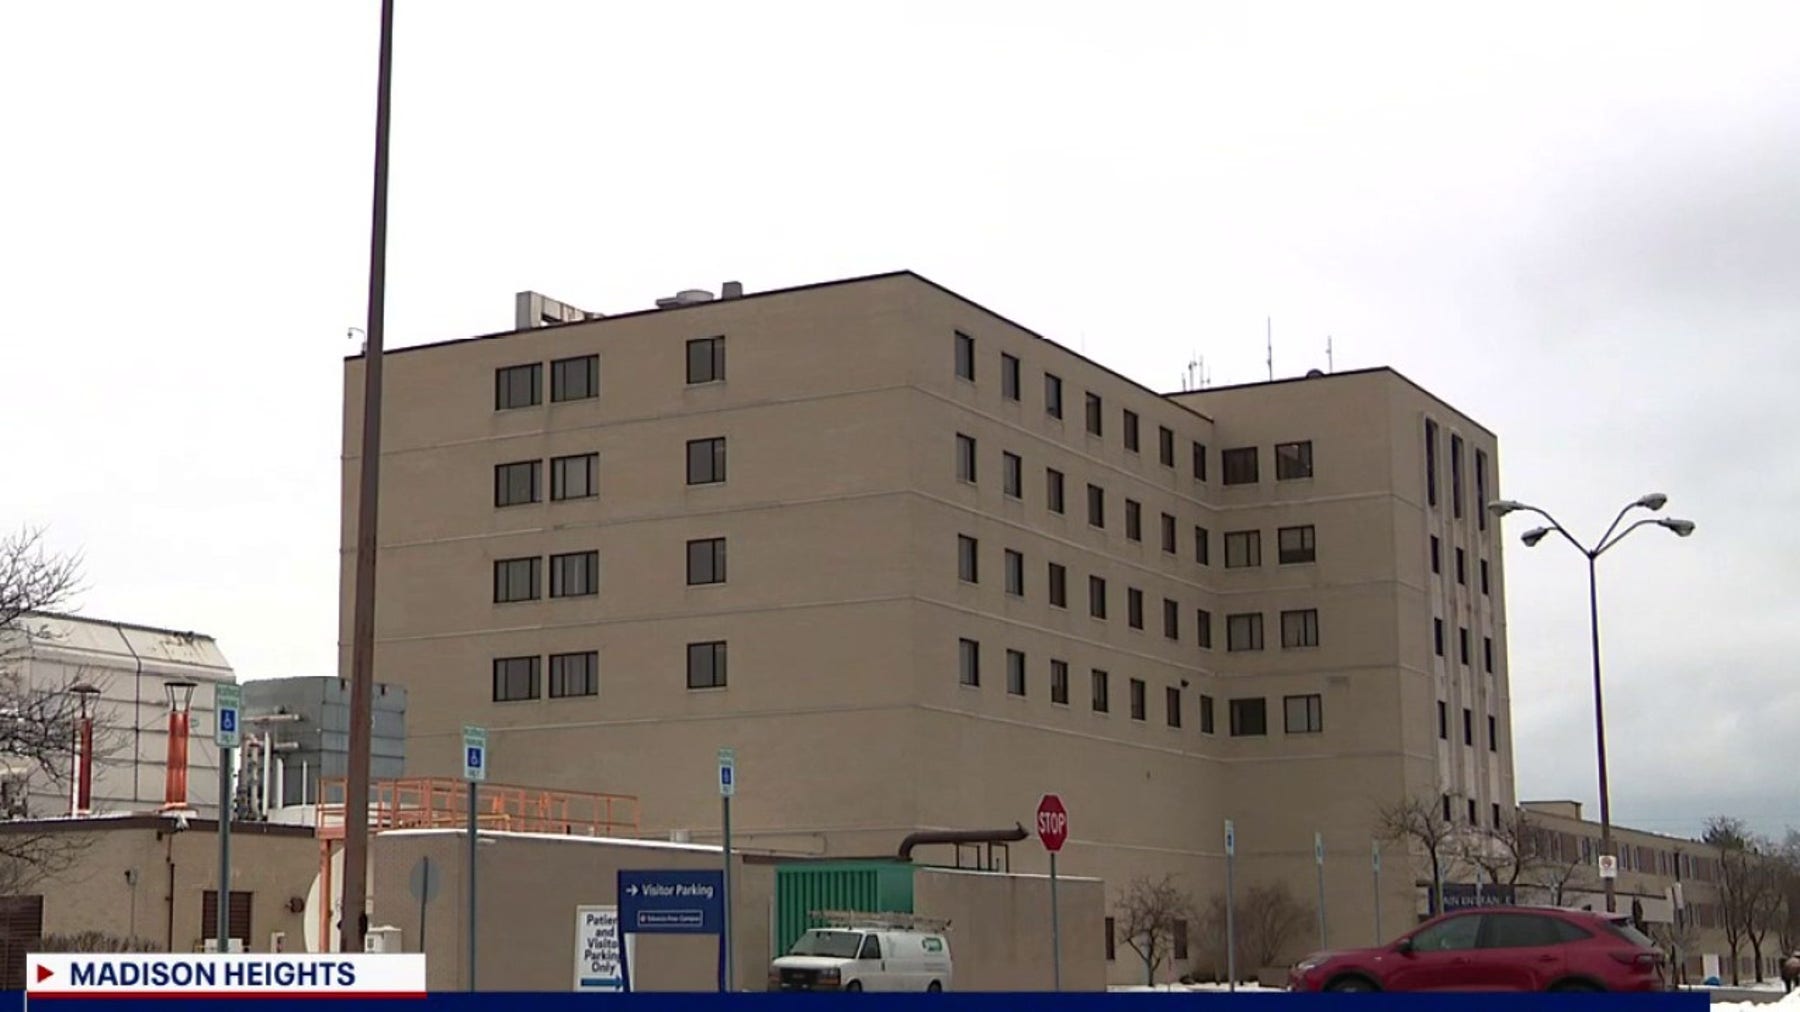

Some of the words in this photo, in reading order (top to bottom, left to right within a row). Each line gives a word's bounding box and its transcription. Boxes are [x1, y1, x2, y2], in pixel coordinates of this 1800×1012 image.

[1040, 811, 1066, 834] STOP
[641, 883, 674, 896] Visitor
[676, 883, 714, 899] Parking
[595, 926, 614, 938] and
[587, 938, 618, 949] Visito
[592, 961, 616, 976] Only
